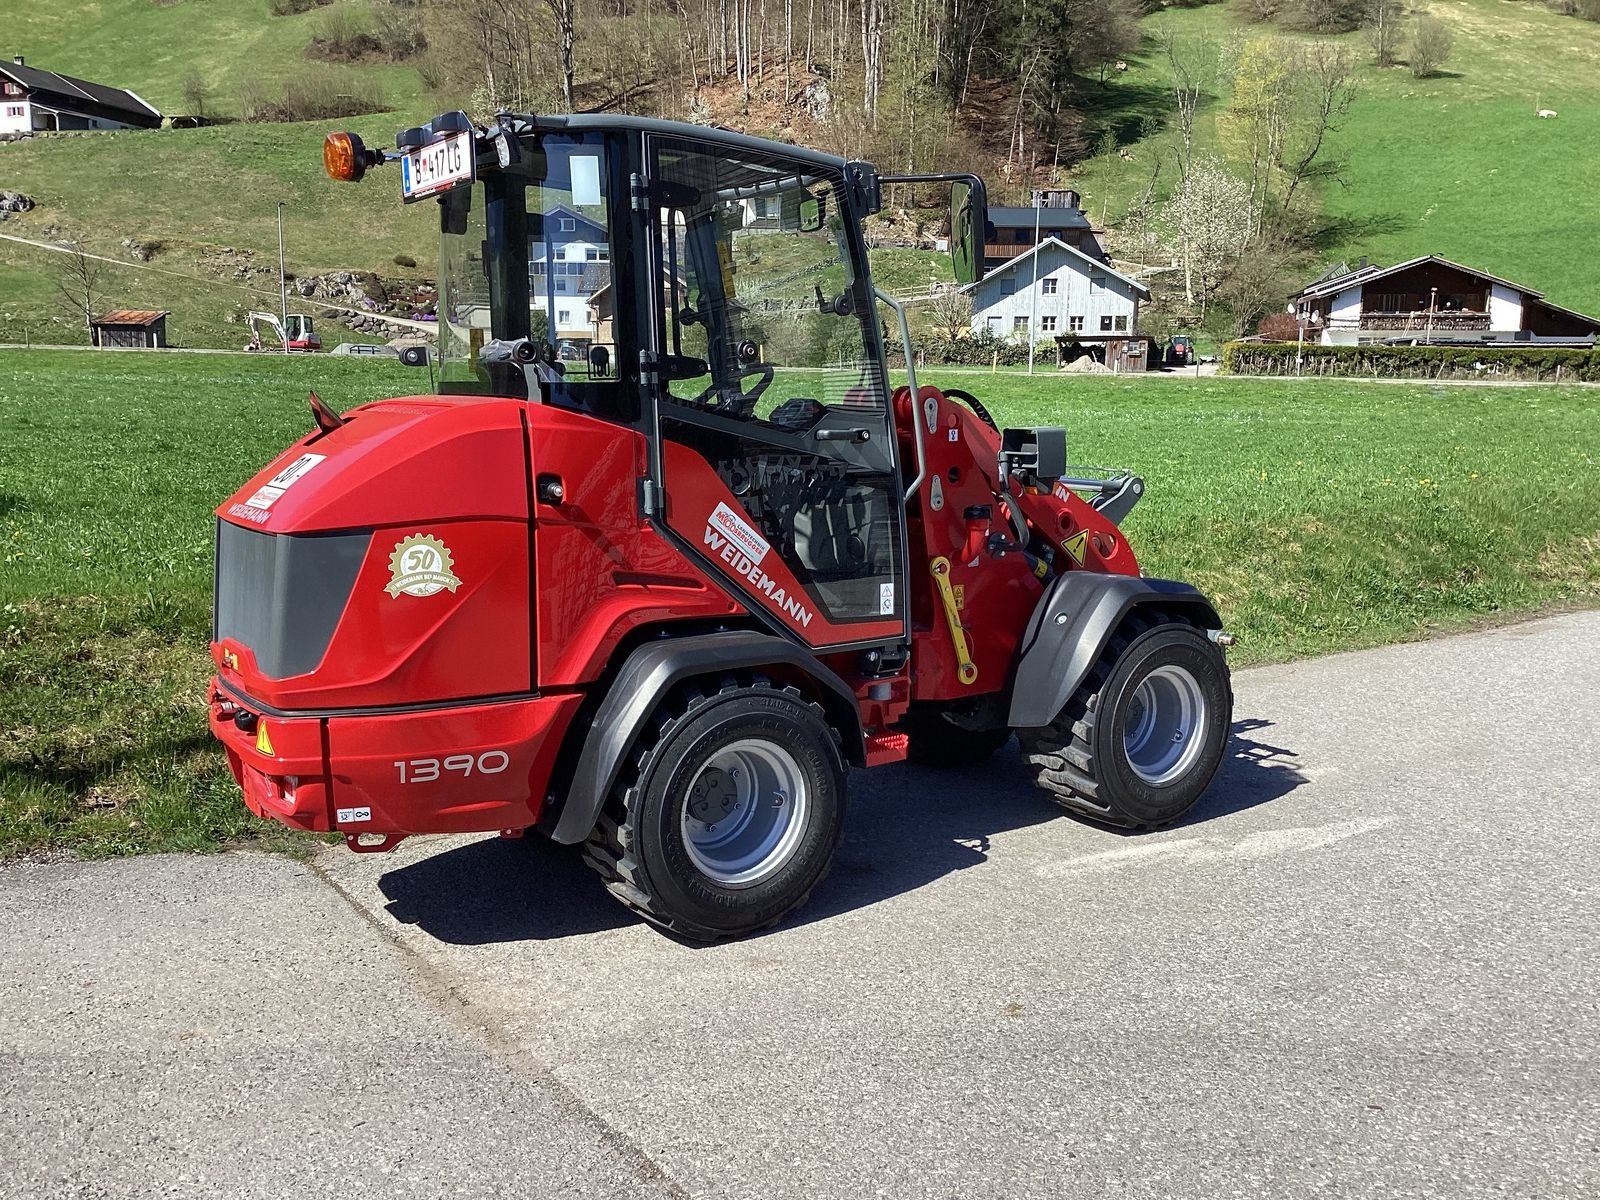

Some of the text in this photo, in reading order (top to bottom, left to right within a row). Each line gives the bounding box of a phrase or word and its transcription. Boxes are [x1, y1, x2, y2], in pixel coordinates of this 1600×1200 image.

[415, 158, 422, 184] B
[226, 503, 273, 525] WEIDEMANN
[715, 511, 763, 556] MOOSBRUGGER
[736, 524, 766, 551] LANDTECHNIK
[407, 548, 436, 571] 50
[703, 525, 813, 628] WEIDEMANN
[393, 749, 510, 784] 1390
